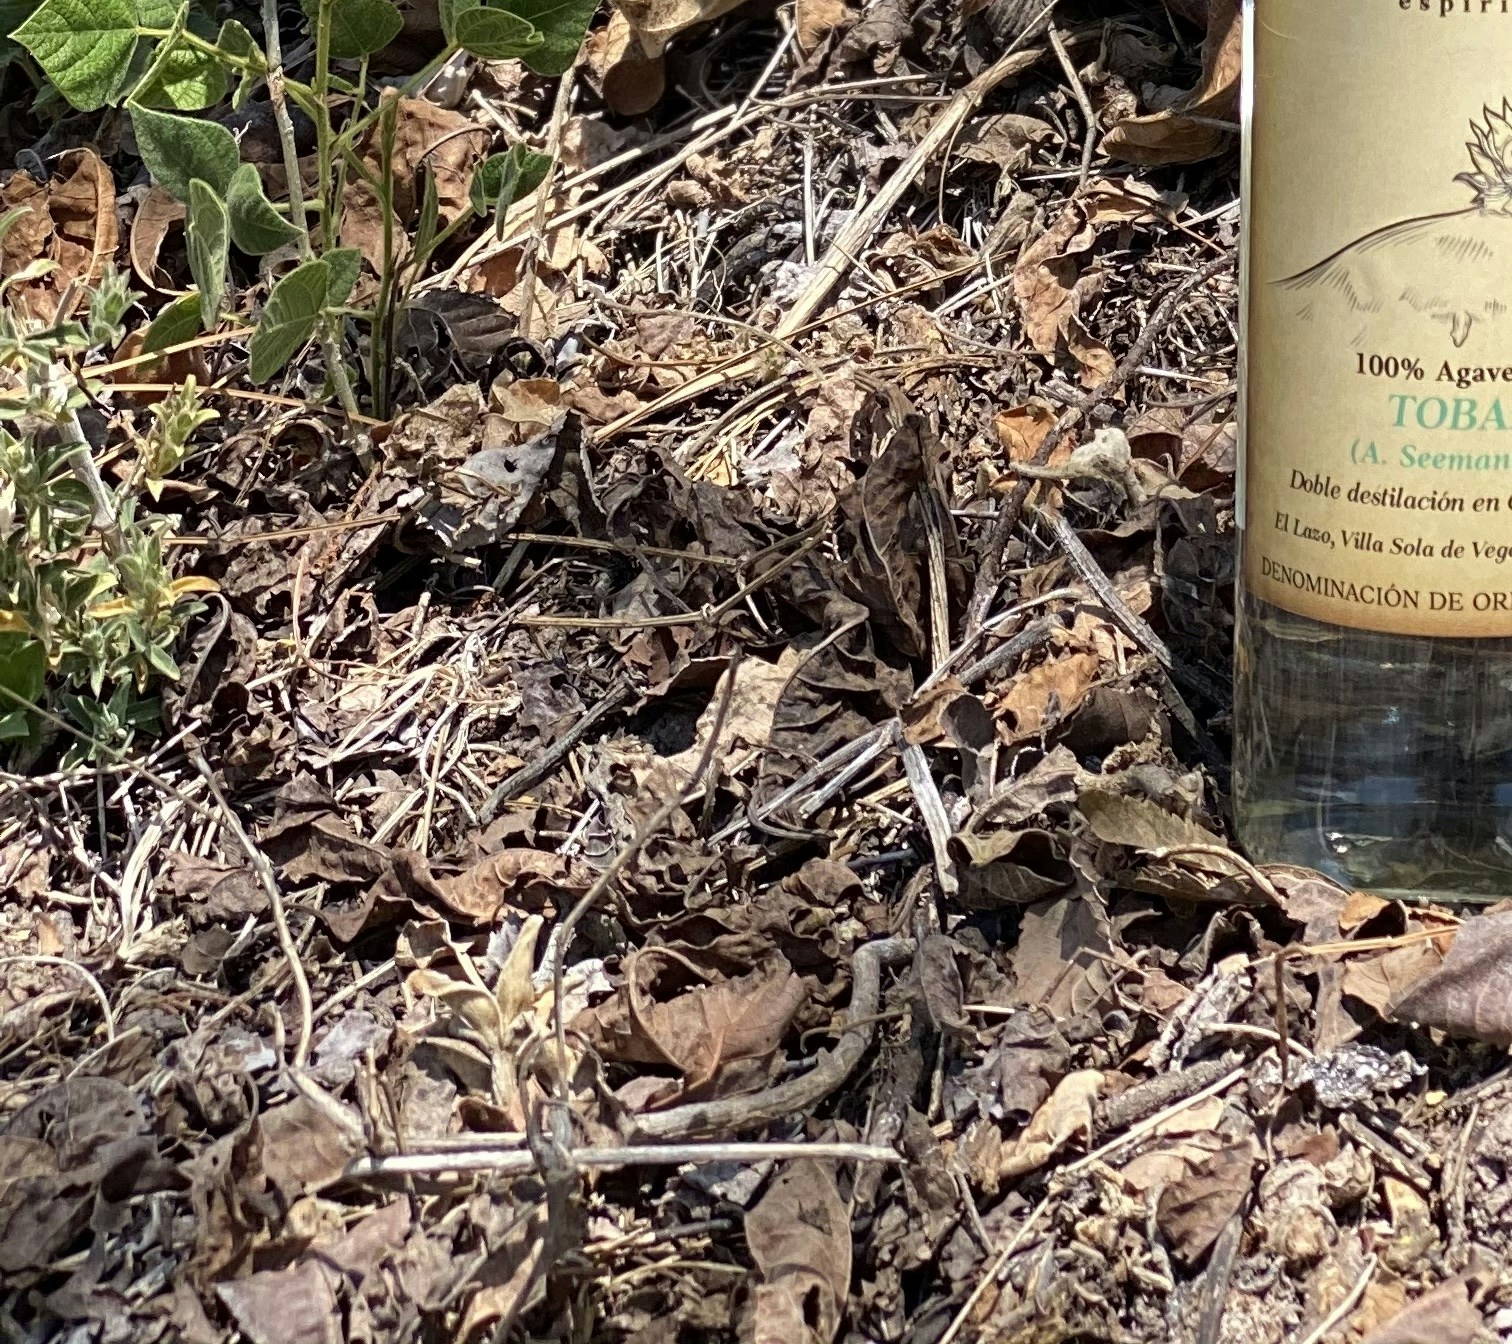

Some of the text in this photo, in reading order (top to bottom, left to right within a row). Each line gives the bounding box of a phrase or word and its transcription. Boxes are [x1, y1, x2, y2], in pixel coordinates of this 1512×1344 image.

[1355, 352, 1425, 381] 100%
[1350, 438, 1387, 466] (A.
[1289, 469, 1341, 500] Doble
[1347, 482, 1465, 513] destilación
[1472, 495, 1500, 513] en
[1274, 511, 1289, 533] El
[1293, 518, 1336, 550] Lazo,
[1341, 530, 1383, 554] Villa
[1389, 537, 1435, 559] Sola
[1441, 539, 1465, 560] de
[1260, 556, 1420, 610] DENOMINACIÓN
[1429, 591, 1464, 612] DE
